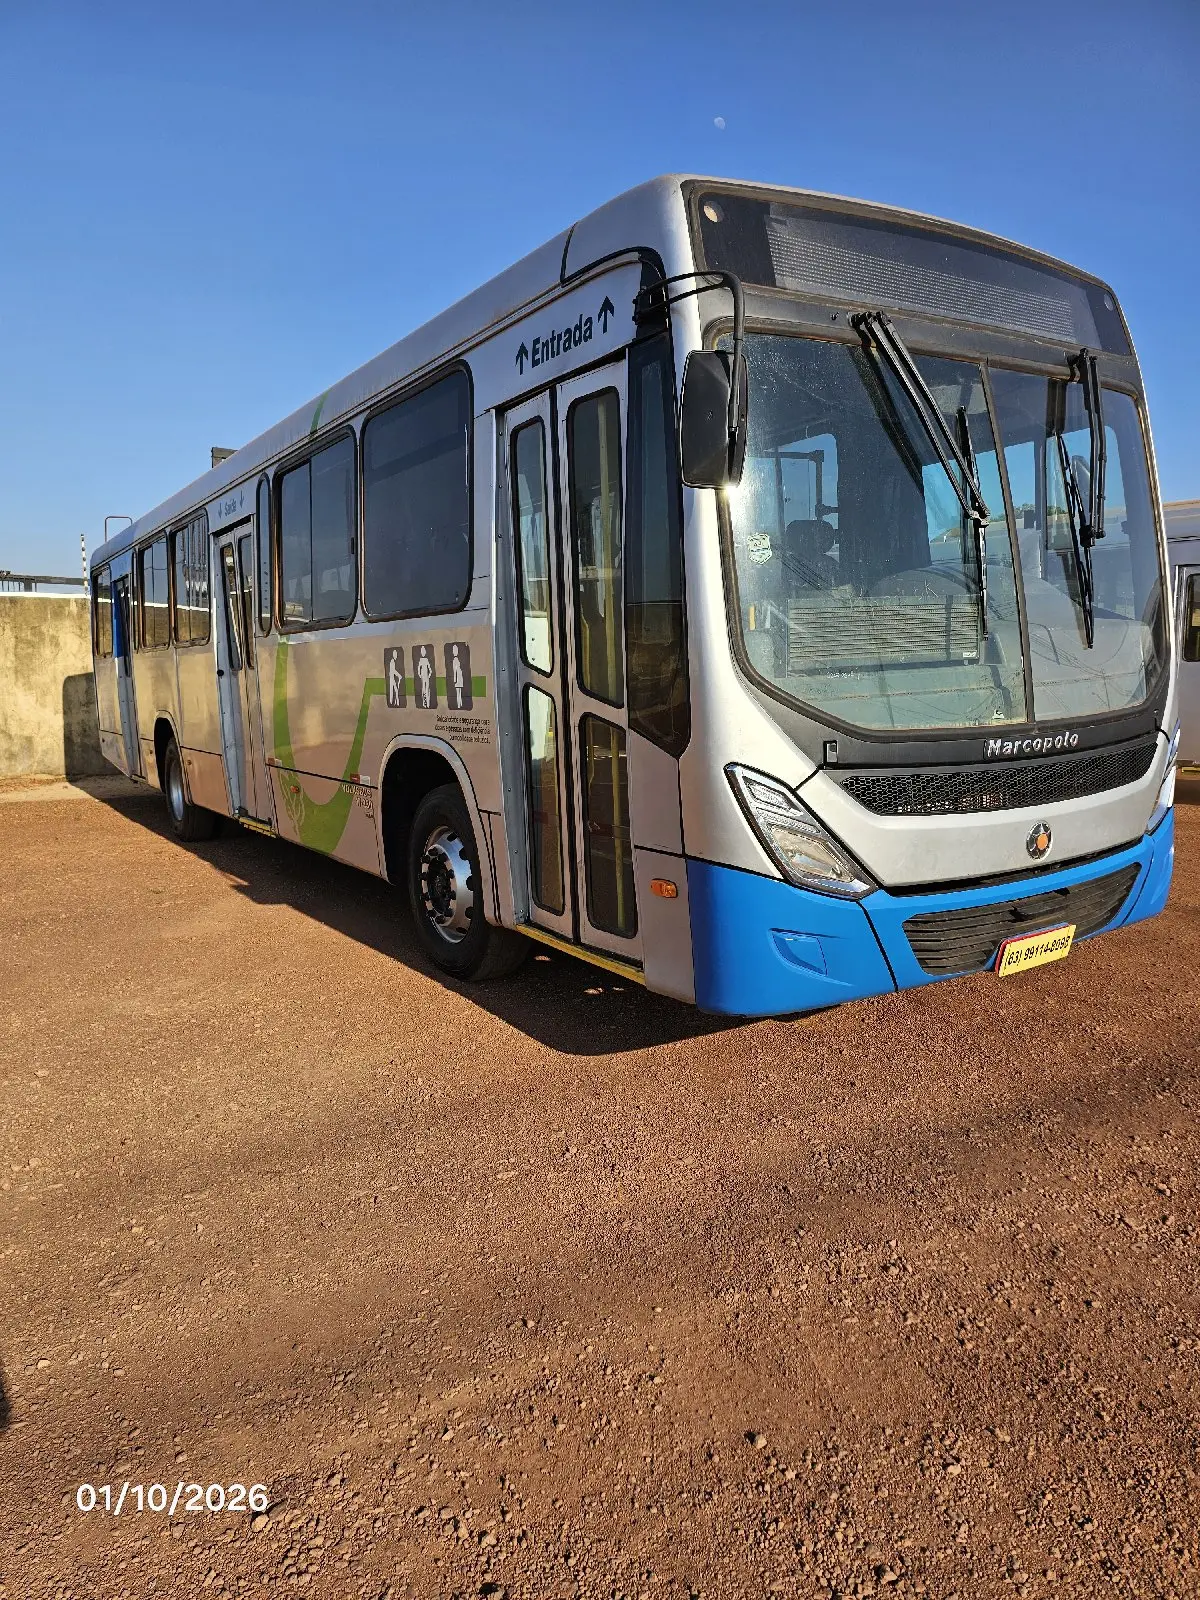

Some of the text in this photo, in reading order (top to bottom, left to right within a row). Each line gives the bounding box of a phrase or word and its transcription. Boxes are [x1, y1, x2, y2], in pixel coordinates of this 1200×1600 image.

[531, 313, 593, 369] Entrada
[987, 731, 1079, 758] Marcopolo
[1005, 949, 1023, 969] (63)
